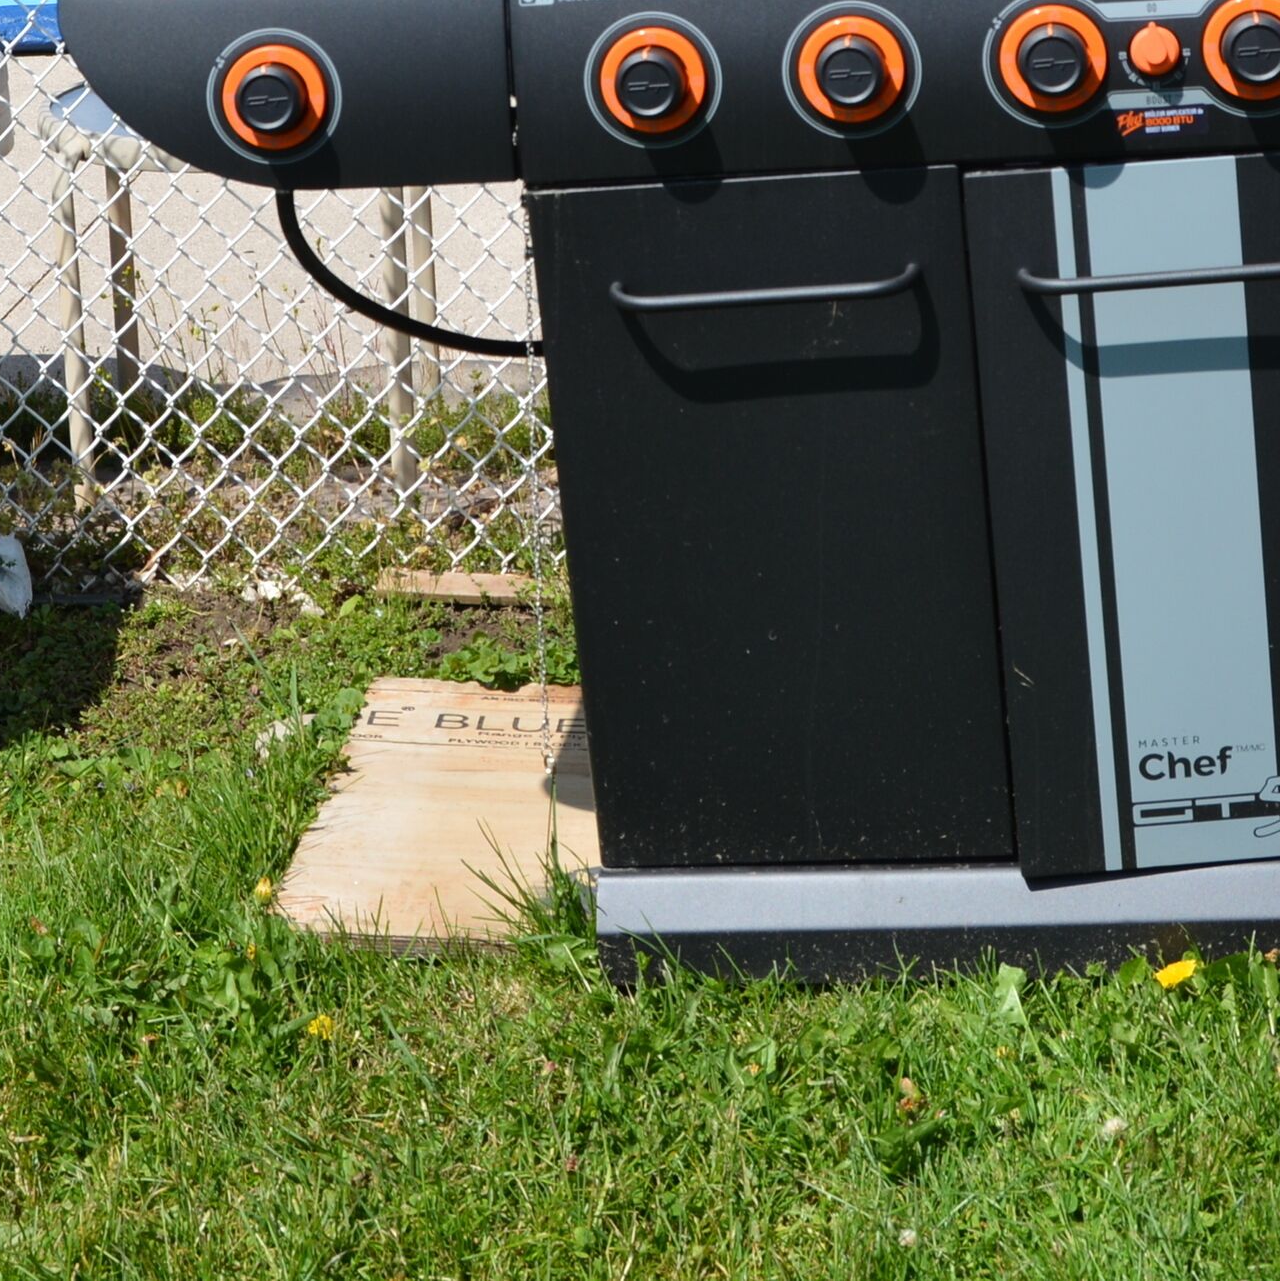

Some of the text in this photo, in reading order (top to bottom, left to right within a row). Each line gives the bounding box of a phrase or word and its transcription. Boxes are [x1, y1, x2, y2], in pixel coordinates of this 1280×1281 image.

[434, 713, 589, 735] BLUE
[1138, 735, 1201, 749] MASTER
[1138, 745, 1234, 781] Chef
